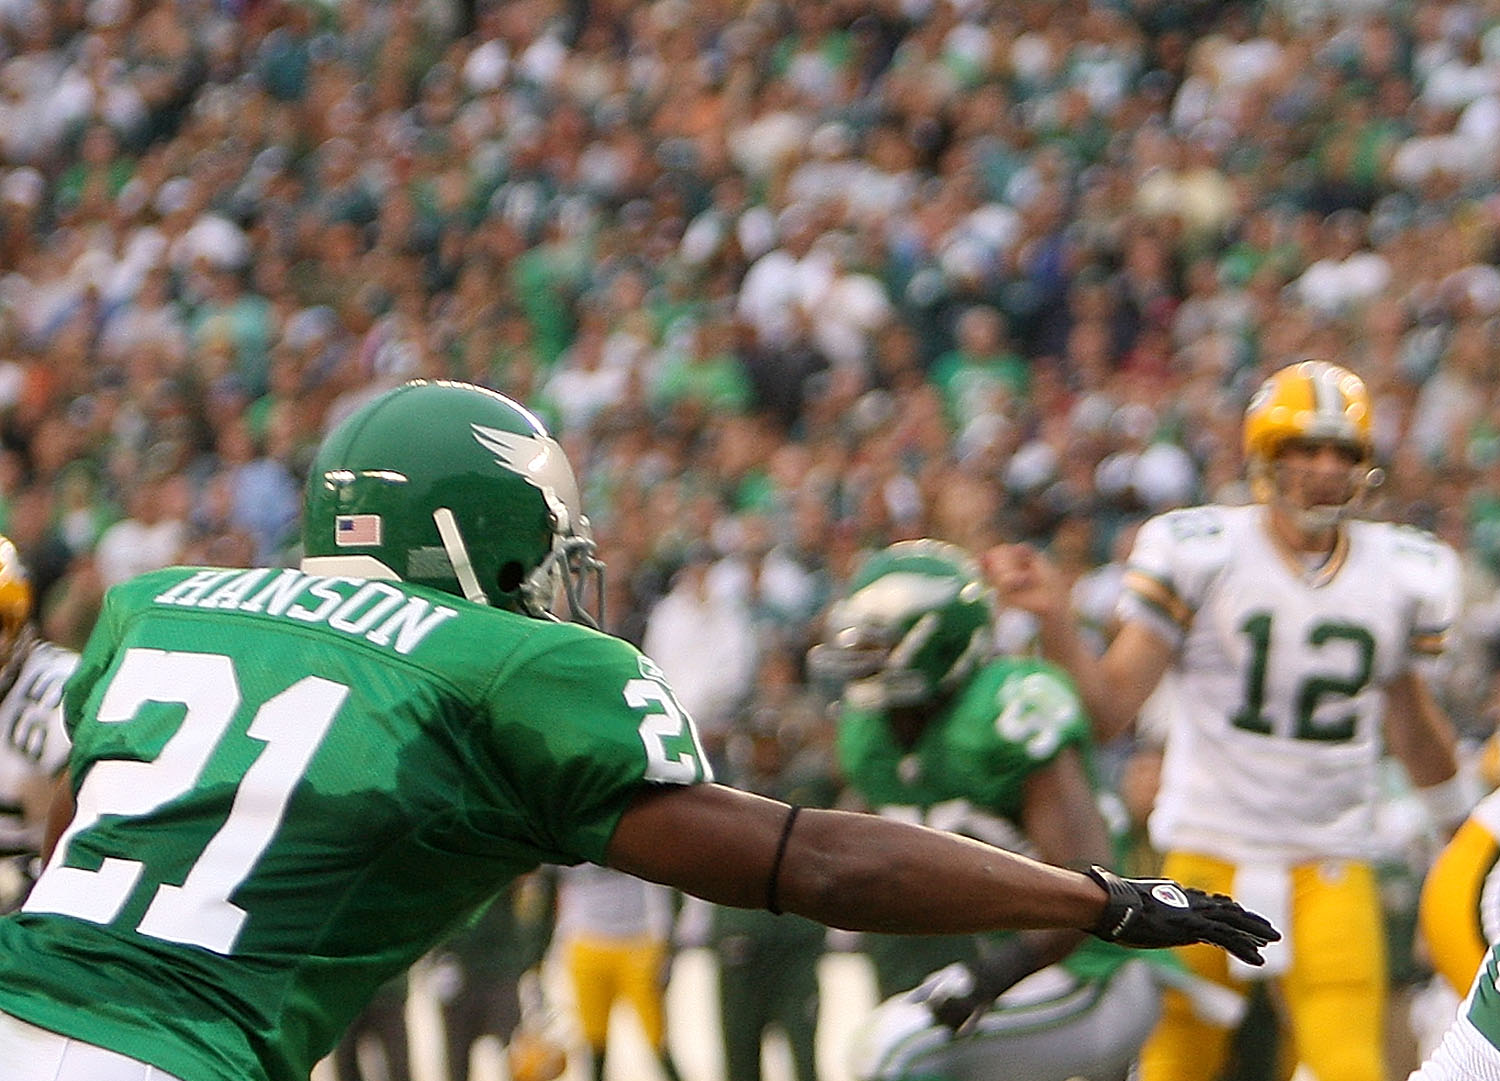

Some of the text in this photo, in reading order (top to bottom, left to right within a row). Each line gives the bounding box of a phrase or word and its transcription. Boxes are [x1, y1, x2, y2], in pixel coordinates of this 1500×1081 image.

[155, 570, 457, 654] HANSON
[1231, 608, 1377, 743] 12
[21, 647, 351, 954] 21
